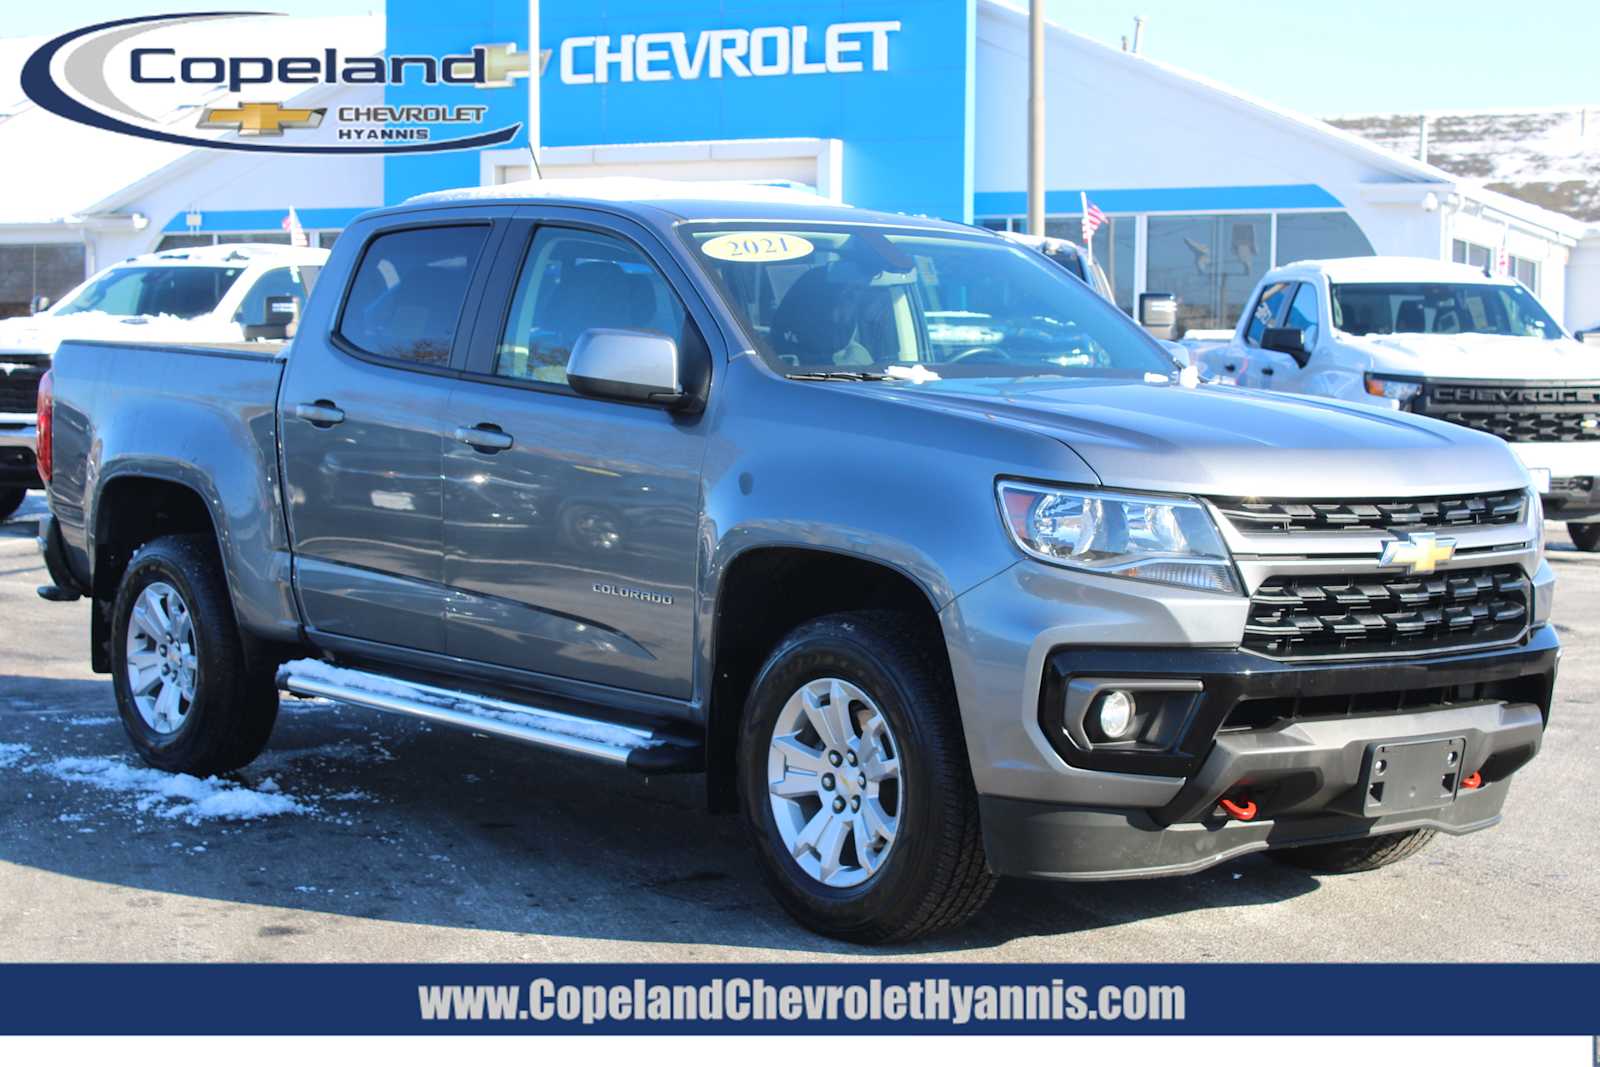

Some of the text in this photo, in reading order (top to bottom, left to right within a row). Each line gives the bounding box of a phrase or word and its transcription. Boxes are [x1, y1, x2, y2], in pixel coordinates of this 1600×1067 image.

[560, 20, 901, 85] CHEVROLET
[728, 237, 788, 256] 2021
[1434, 388, 1600, 402] CHEVROLE
[592, 583, 672, 604] COLORADO
